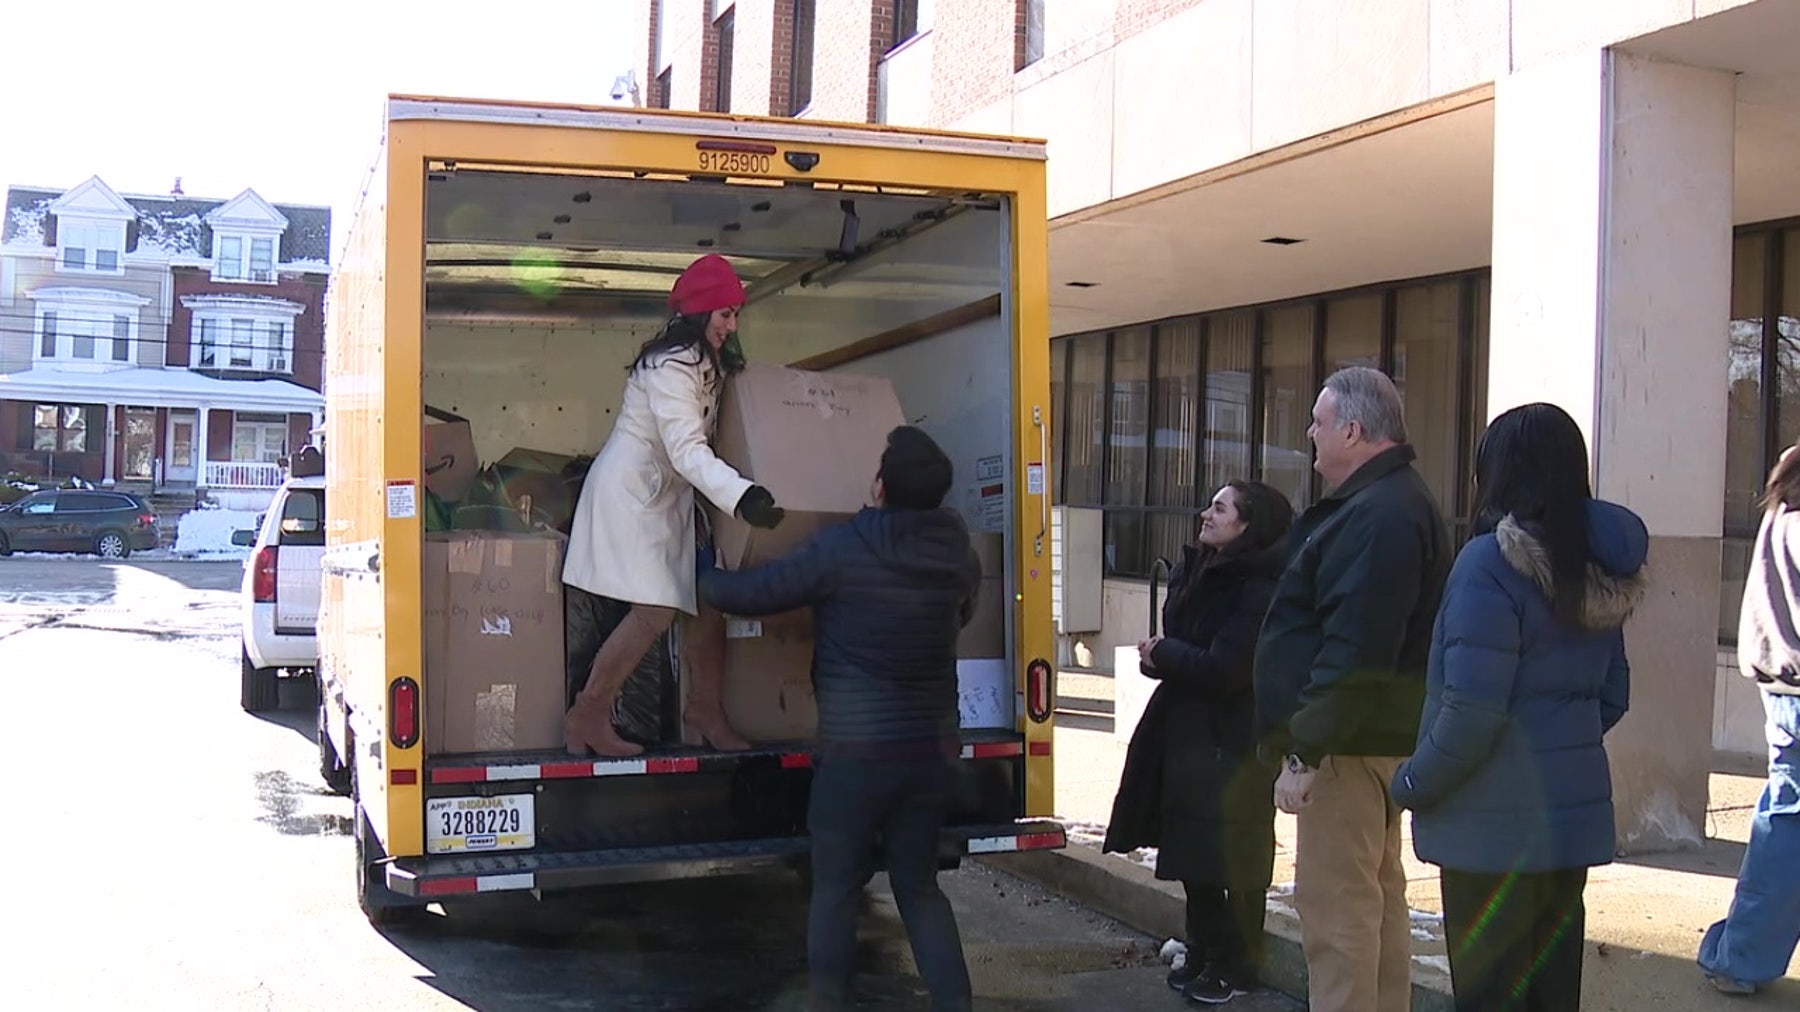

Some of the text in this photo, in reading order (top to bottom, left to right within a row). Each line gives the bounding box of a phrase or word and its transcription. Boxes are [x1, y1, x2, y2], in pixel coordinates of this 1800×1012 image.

[699, 152, 770, 173] 9125900
[457, 798, 504, 810] INDIANA
[441, 808, 520, 836] 3288229
